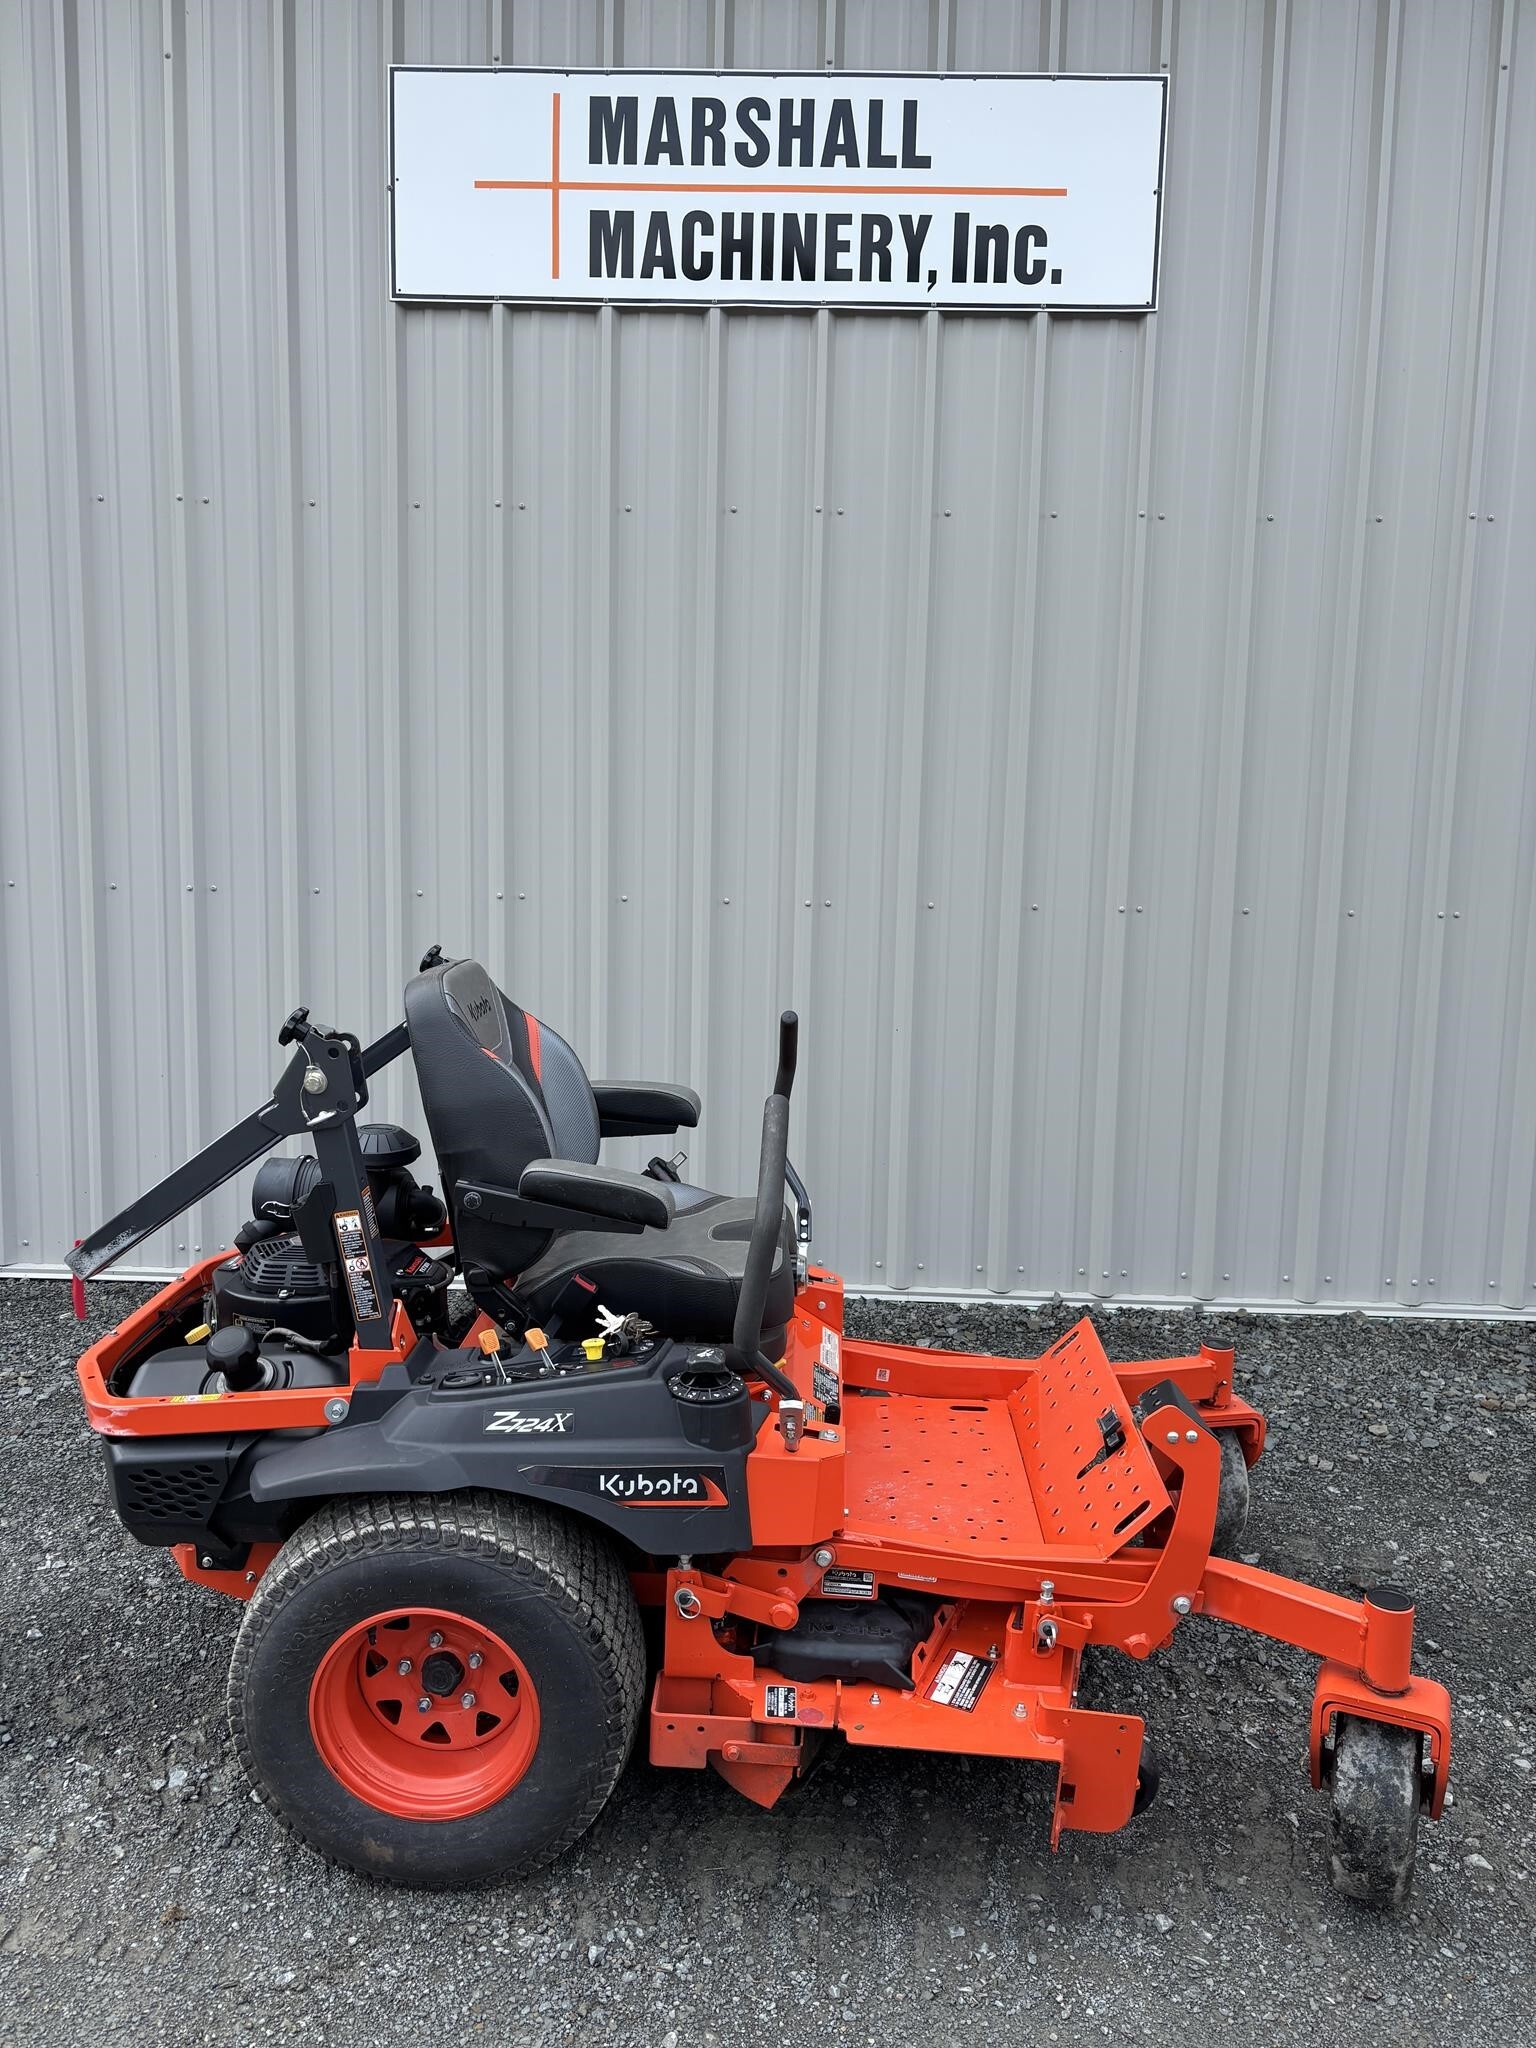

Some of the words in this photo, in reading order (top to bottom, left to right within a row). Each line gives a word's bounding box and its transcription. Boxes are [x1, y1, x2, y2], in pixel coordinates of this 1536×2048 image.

[588, 95, 932, 170] MARSHALL
[588, 209, 937, 293] MACHINERY,
[952, 212, 1062, 286] Inc.
[467, 995, 491, 1021] Kubota
[485, 1411, 574, 1433] Z724X
[599, 1473, 698, 1497] Kubota
[832, 1569, 857, 1578] Kubota
